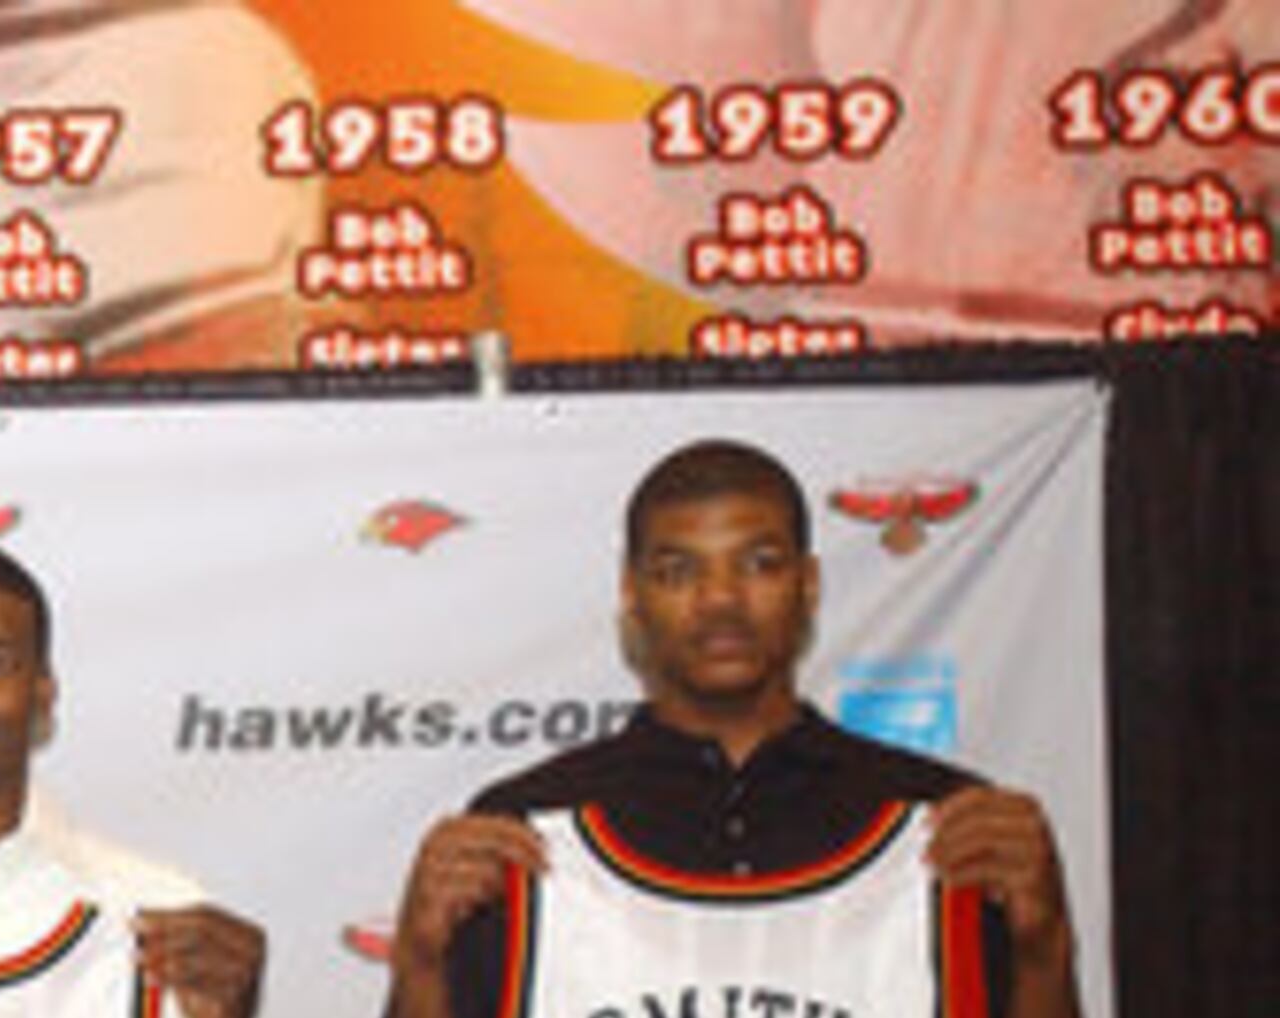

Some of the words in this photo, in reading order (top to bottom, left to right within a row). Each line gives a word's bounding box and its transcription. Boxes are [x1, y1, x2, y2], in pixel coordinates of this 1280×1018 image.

[266, 103, 500, 171] 1958
[652, 83, 897, 160] 1959
[722, 191, 830, 238] Bob
[1129, 176, 1236, 221] Bob
[333, 204, 432, 248] Bob
[1096, 219, 1270, 265] Pettit
[303, 246, 468, 291] Pettit
[691, 237, 862, 281] Pettit
